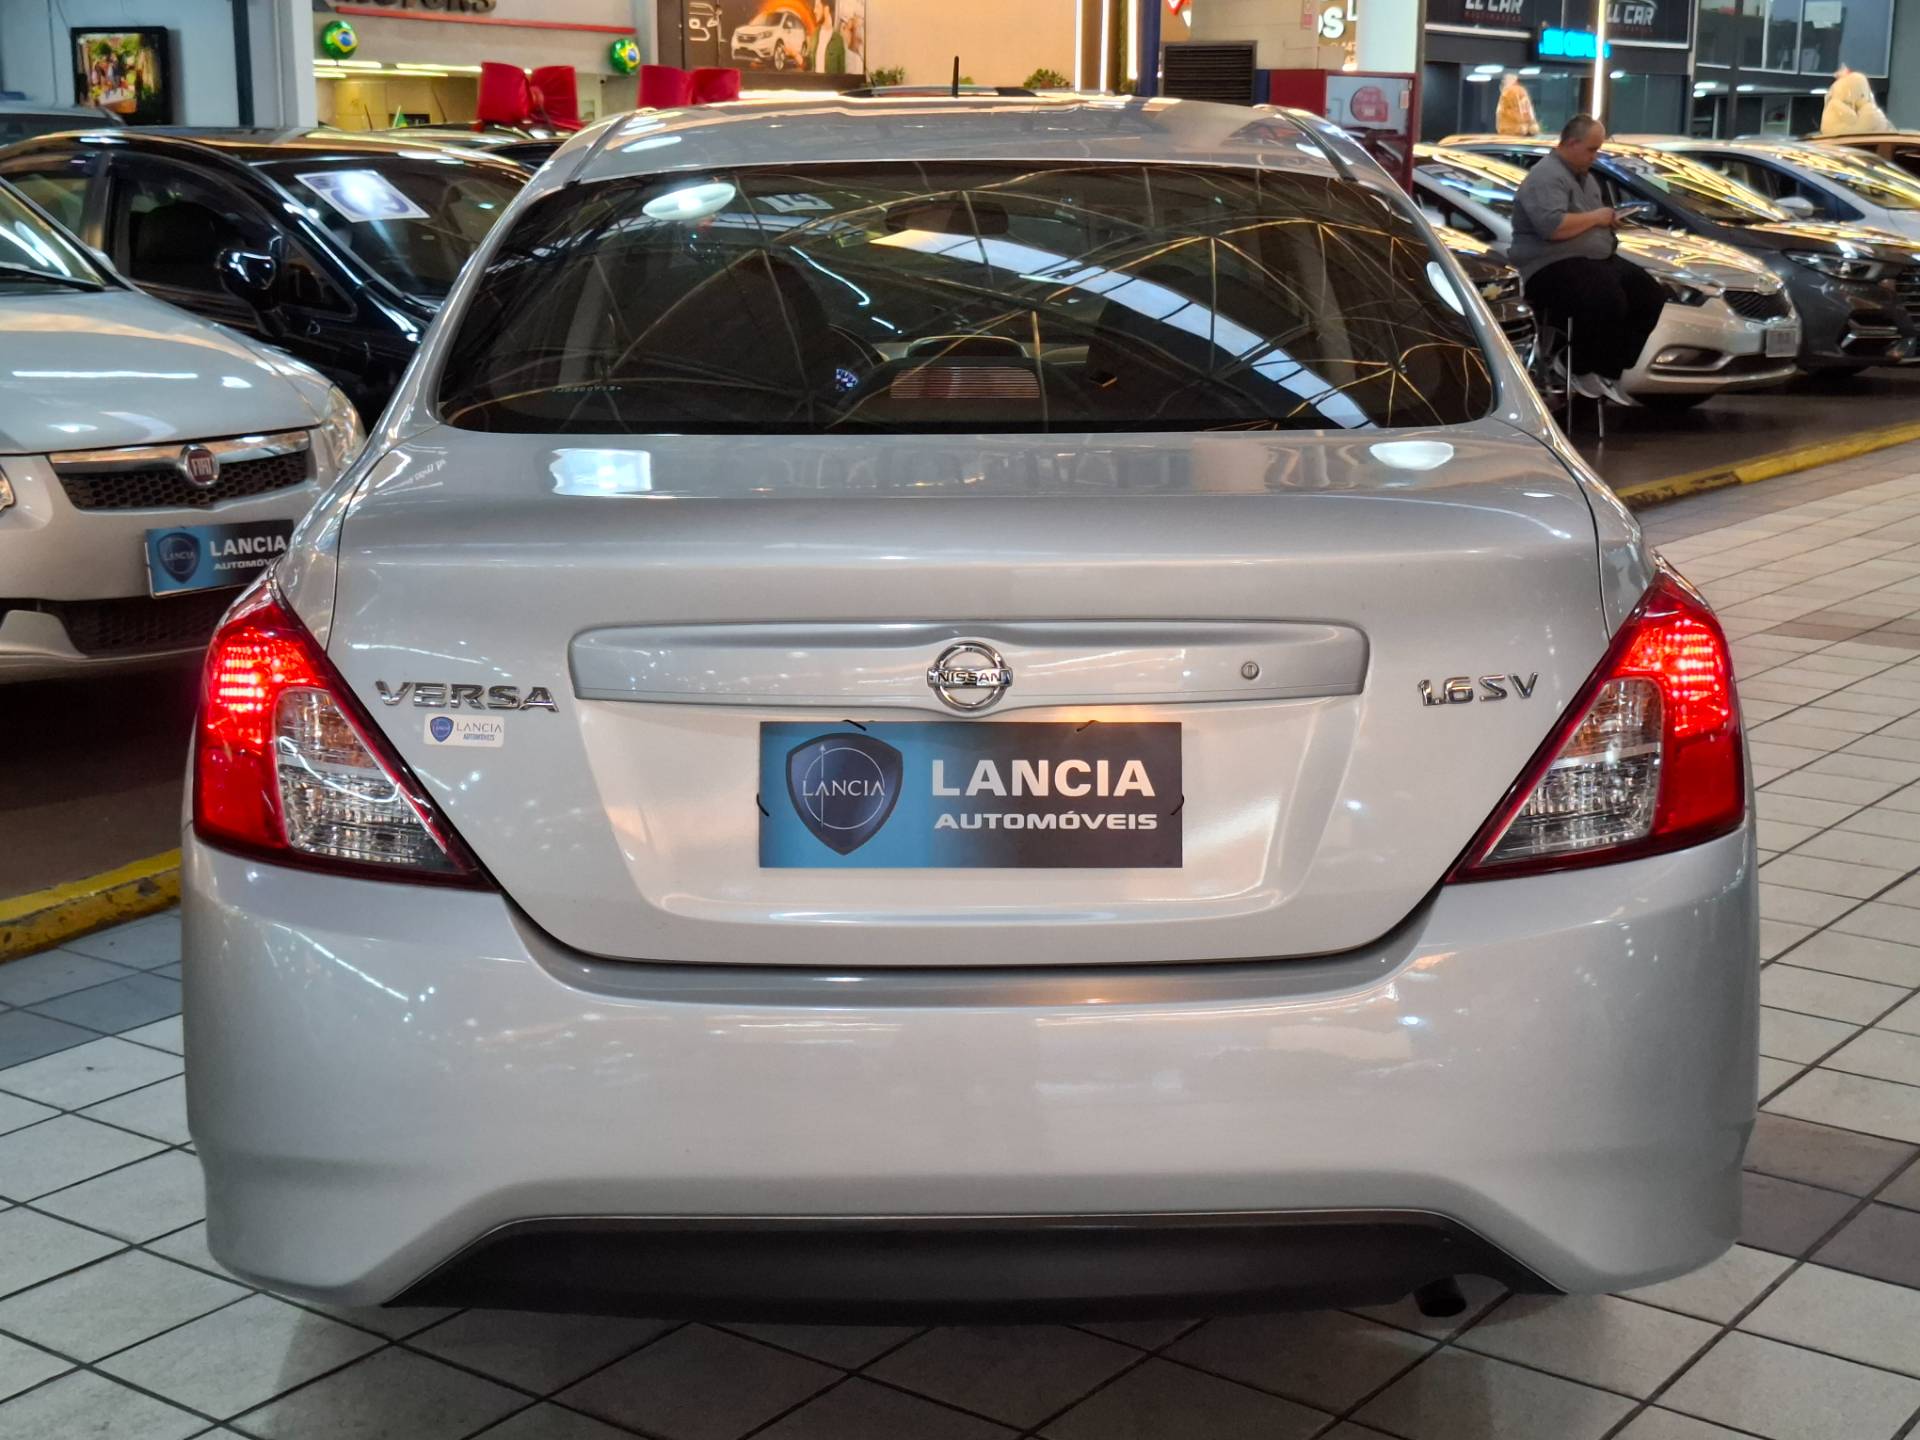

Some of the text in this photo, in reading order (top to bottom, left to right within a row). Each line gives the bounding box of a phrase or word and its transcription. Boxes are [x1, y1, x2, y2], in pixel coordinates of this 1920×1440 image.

[1623, 5, 1655, 26] CAR
[191, 457, 214, 476] FIAT
[210, 535, 287, 557] LANCIA
[937, 672, 1001, 682] NISSAN
[375, 680, 560, 712] VERSA
[457, 722, 502, 733] LANCIA
[802, 780, 885, 796] LANCIA
[932, 760, 1156, 797] LANCIA
[934, 811, 1158, 830] AUTOMÓVEIS
